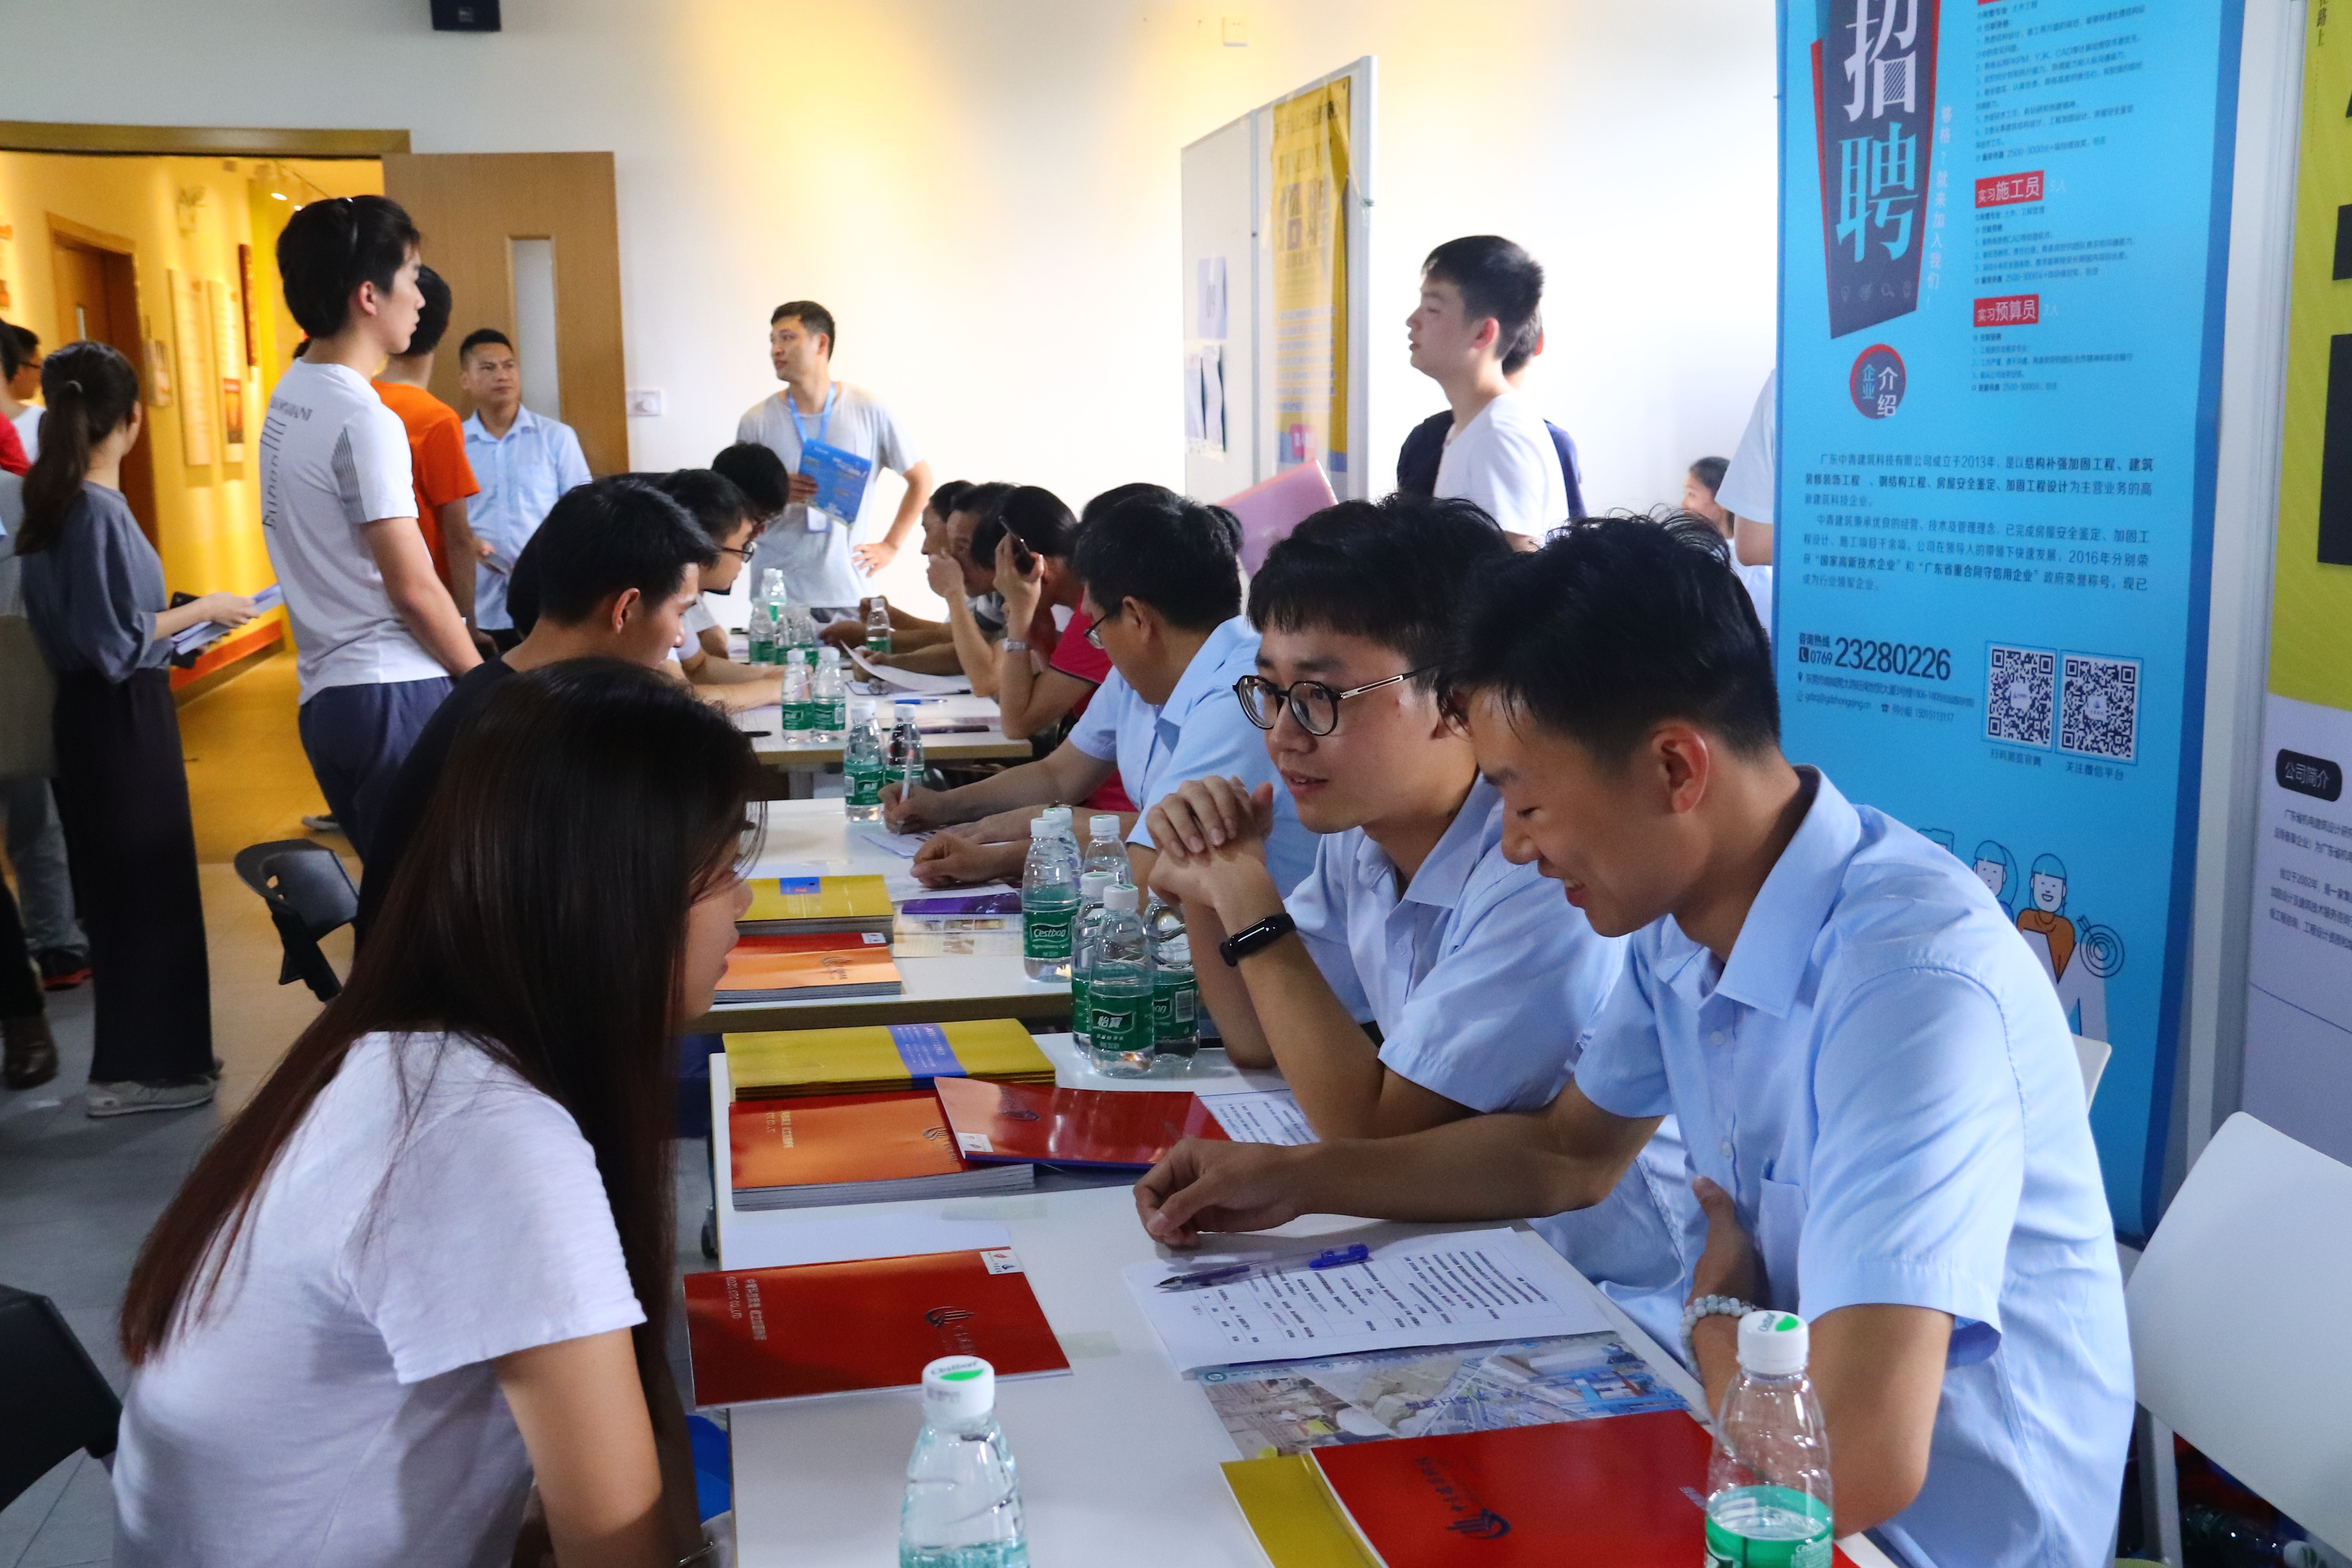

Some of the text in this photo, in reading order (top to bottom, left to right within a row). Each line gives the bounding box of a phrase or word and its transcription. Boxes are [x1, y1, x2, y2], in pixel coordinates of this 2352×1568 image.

[1978, 176, 2040, 203] 实习施工员
[1978, 300, 2036, 322] 实习预算员
[1877, 367, 1898, 416] 介绍
[1810, 637, 1951, 680] 0769 23280226
[2285, 761, 2329, 790] 公司简介
